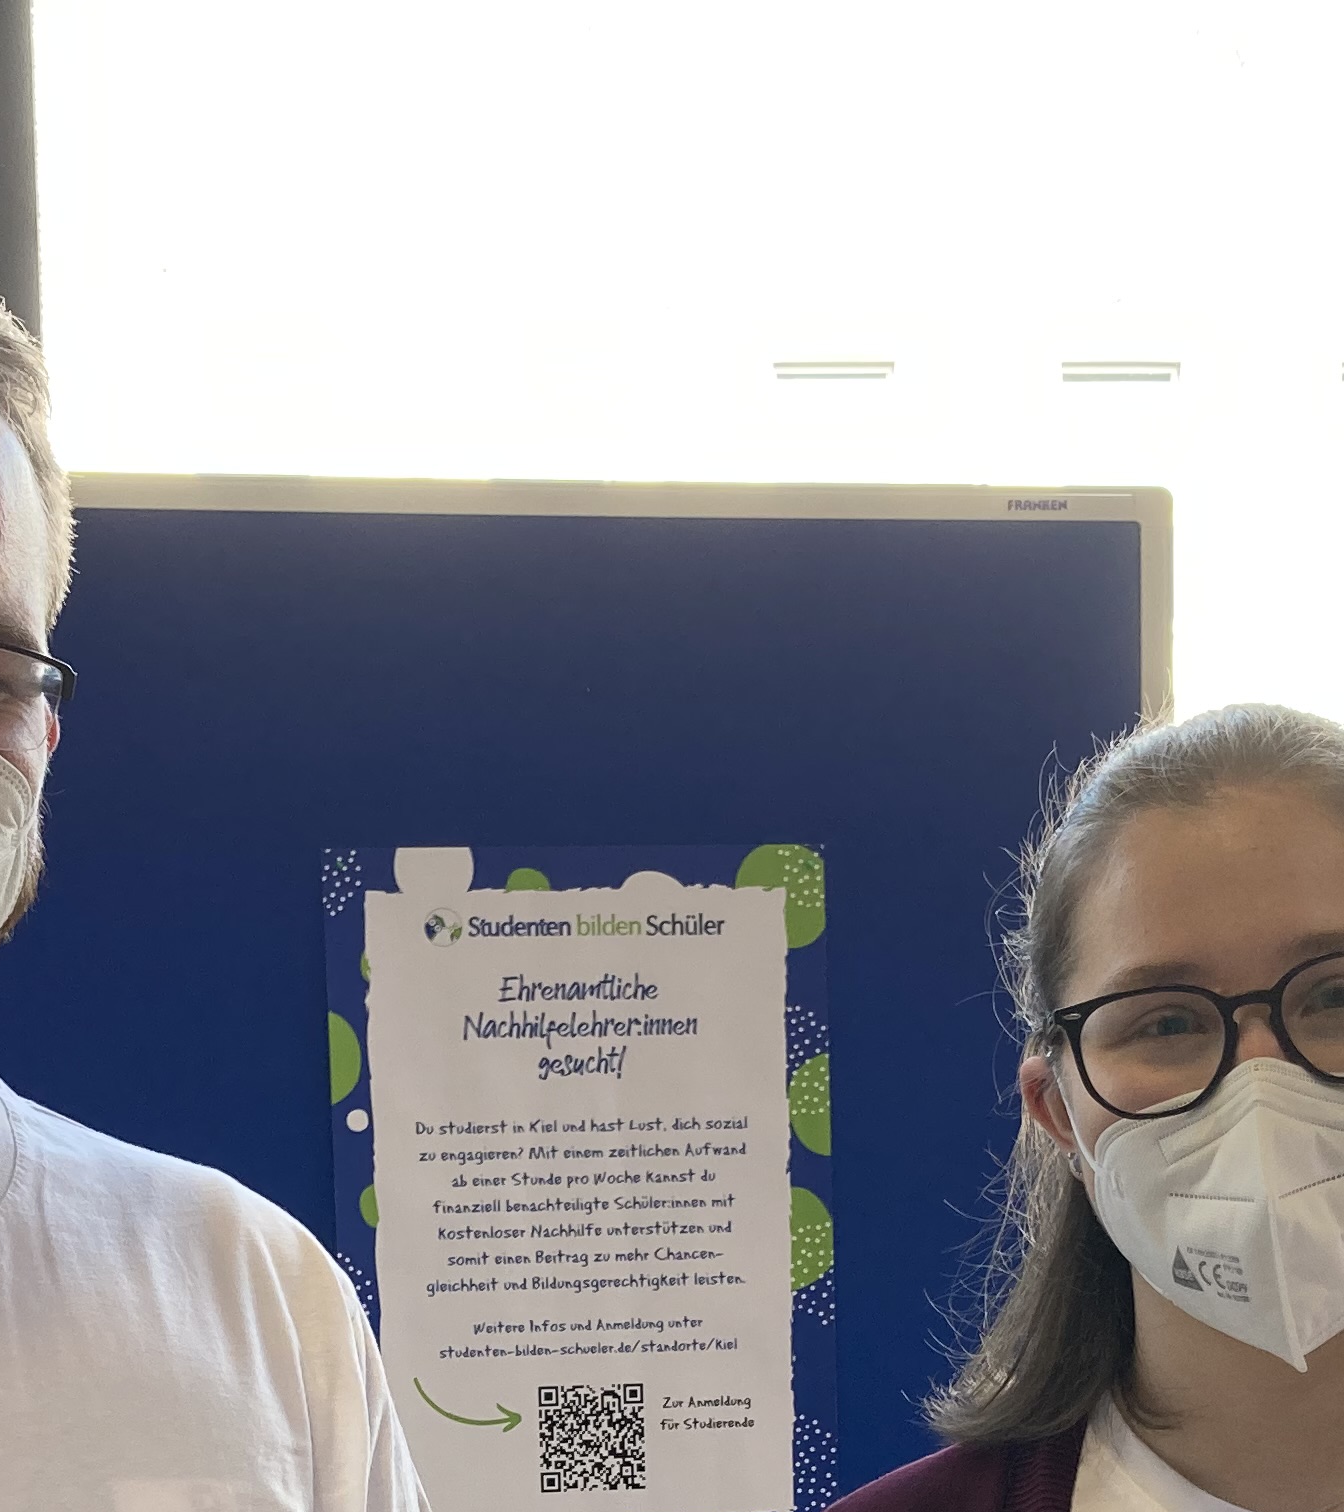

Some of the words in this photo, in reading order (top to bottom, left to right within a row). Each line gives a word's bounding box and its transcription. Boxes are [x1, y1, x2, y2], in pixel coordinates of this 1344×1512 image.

[468, 914, 572, 937] Studenten
[576, 913, 642, 936] bilden
[645, 913, 725, 937] Schüler
[498, 972, 660, 1003] Ehrenamtliche
[463, 1009, 698, 1050] Nachhilfelehrer:innen
[538, 1045, 627, 1081] gesucht!
[415, 1121, 435, 1135] Du
[439, 1119, 508, 1135] studierst
[512, 1121, 525, 1133] in
[529, 1118, 558, 1133] Kiel
[562, 1119, 586, 1133] und
[590, 1117, 624, 1132] hast
[672, 1116, 701, 1131] dich
[705, 1116, 748, 1129] sozial
[418, 1151, 436, 1162] zu
[440, 1147, 524, 1165] engagieren?
[528, 1145, 559, 1160] Mit
[563, 1146, 604, 1159] einem
[608, 1143, 680, 1158] zeitlichen
[684, 1142, 746, 1157] Aufwand
[451, 1174, 468, 1188] ab
[472, 1173, 506, 1187] einer
[511, 1172, 562, 1186] Stunde
[567, 1174, 589, 1189] pro
[593, 1170, 641, 1185] Woche
[700, 1169, 716, 1182] du
[432, 1199, 502, 1214] finanziell
[505, 1197, 609, 1215] benachteiligte
[711, 1193, 736, 1208] mit
[530, 1223, 602, 1239] Nachhilfe
[607, 1221, 704, 1236] unterstützen
[708, 1220, 732, 1234] und
[447, 1252, 490, 1266] somit
[494, 1253, 531, 1265] einen
[535, 1250, 589, 1268] Beitrag
[593, 1253, 610, 1262] zu
[615, 1247, 650, 1262] mehr
[654, 1247, 725, 1261] Chancen-
[426, 1277, 498, 1298] gleichheit
[503, 1277, 528, 1291] und
[532, 1272, 689, 1294] Bildungsgerechtigkeit
[473, 1321, 525, 1335] Weitere
[529, 1319, 567, 1333] Infos
[570, 1319, 592, 1332] und
[596, 1318, 664, 1333] Anmeldung
[668, 1316, 704, 1329] unter
[662, 1396, 684, 1409] Zur
[687, 1395, 752, 1410] Anmeldung
[660, 1418, 680, 1431] für
[683, 1416, 755, 1430] Studierende
